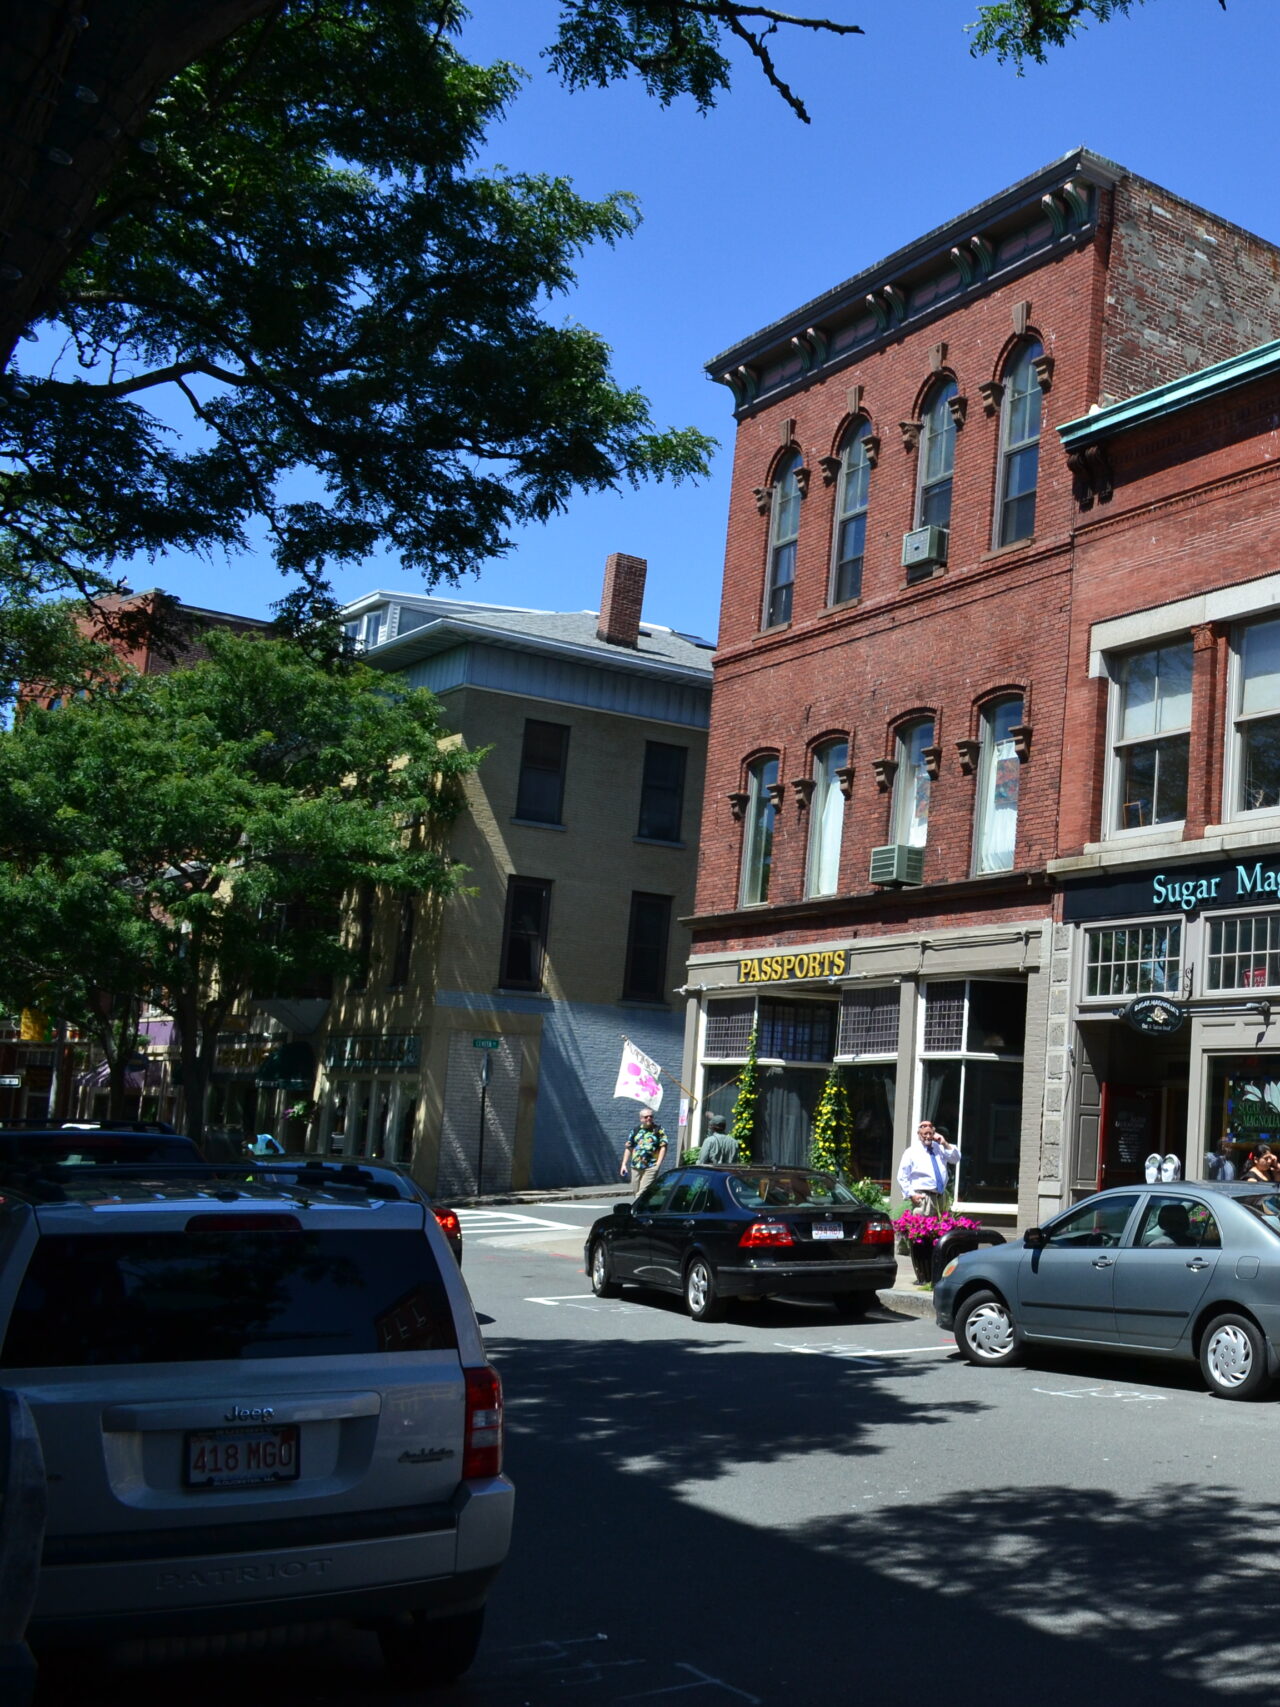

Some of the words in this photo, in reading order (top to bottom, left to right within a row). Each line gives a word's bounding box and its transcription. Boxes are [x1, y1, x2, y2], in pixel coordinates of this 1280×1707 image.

[1153, 875, 1221, 910] Sugar
[739, 950, 846, 983] PASSPORTS
[1239, 1102, 1262, 1115] SUGAR
[224, 1405, 275, 1422] Jeep
[193, 1444, 239, 1473] 418
[156, 1558, 333, 1590] PATRIOT
